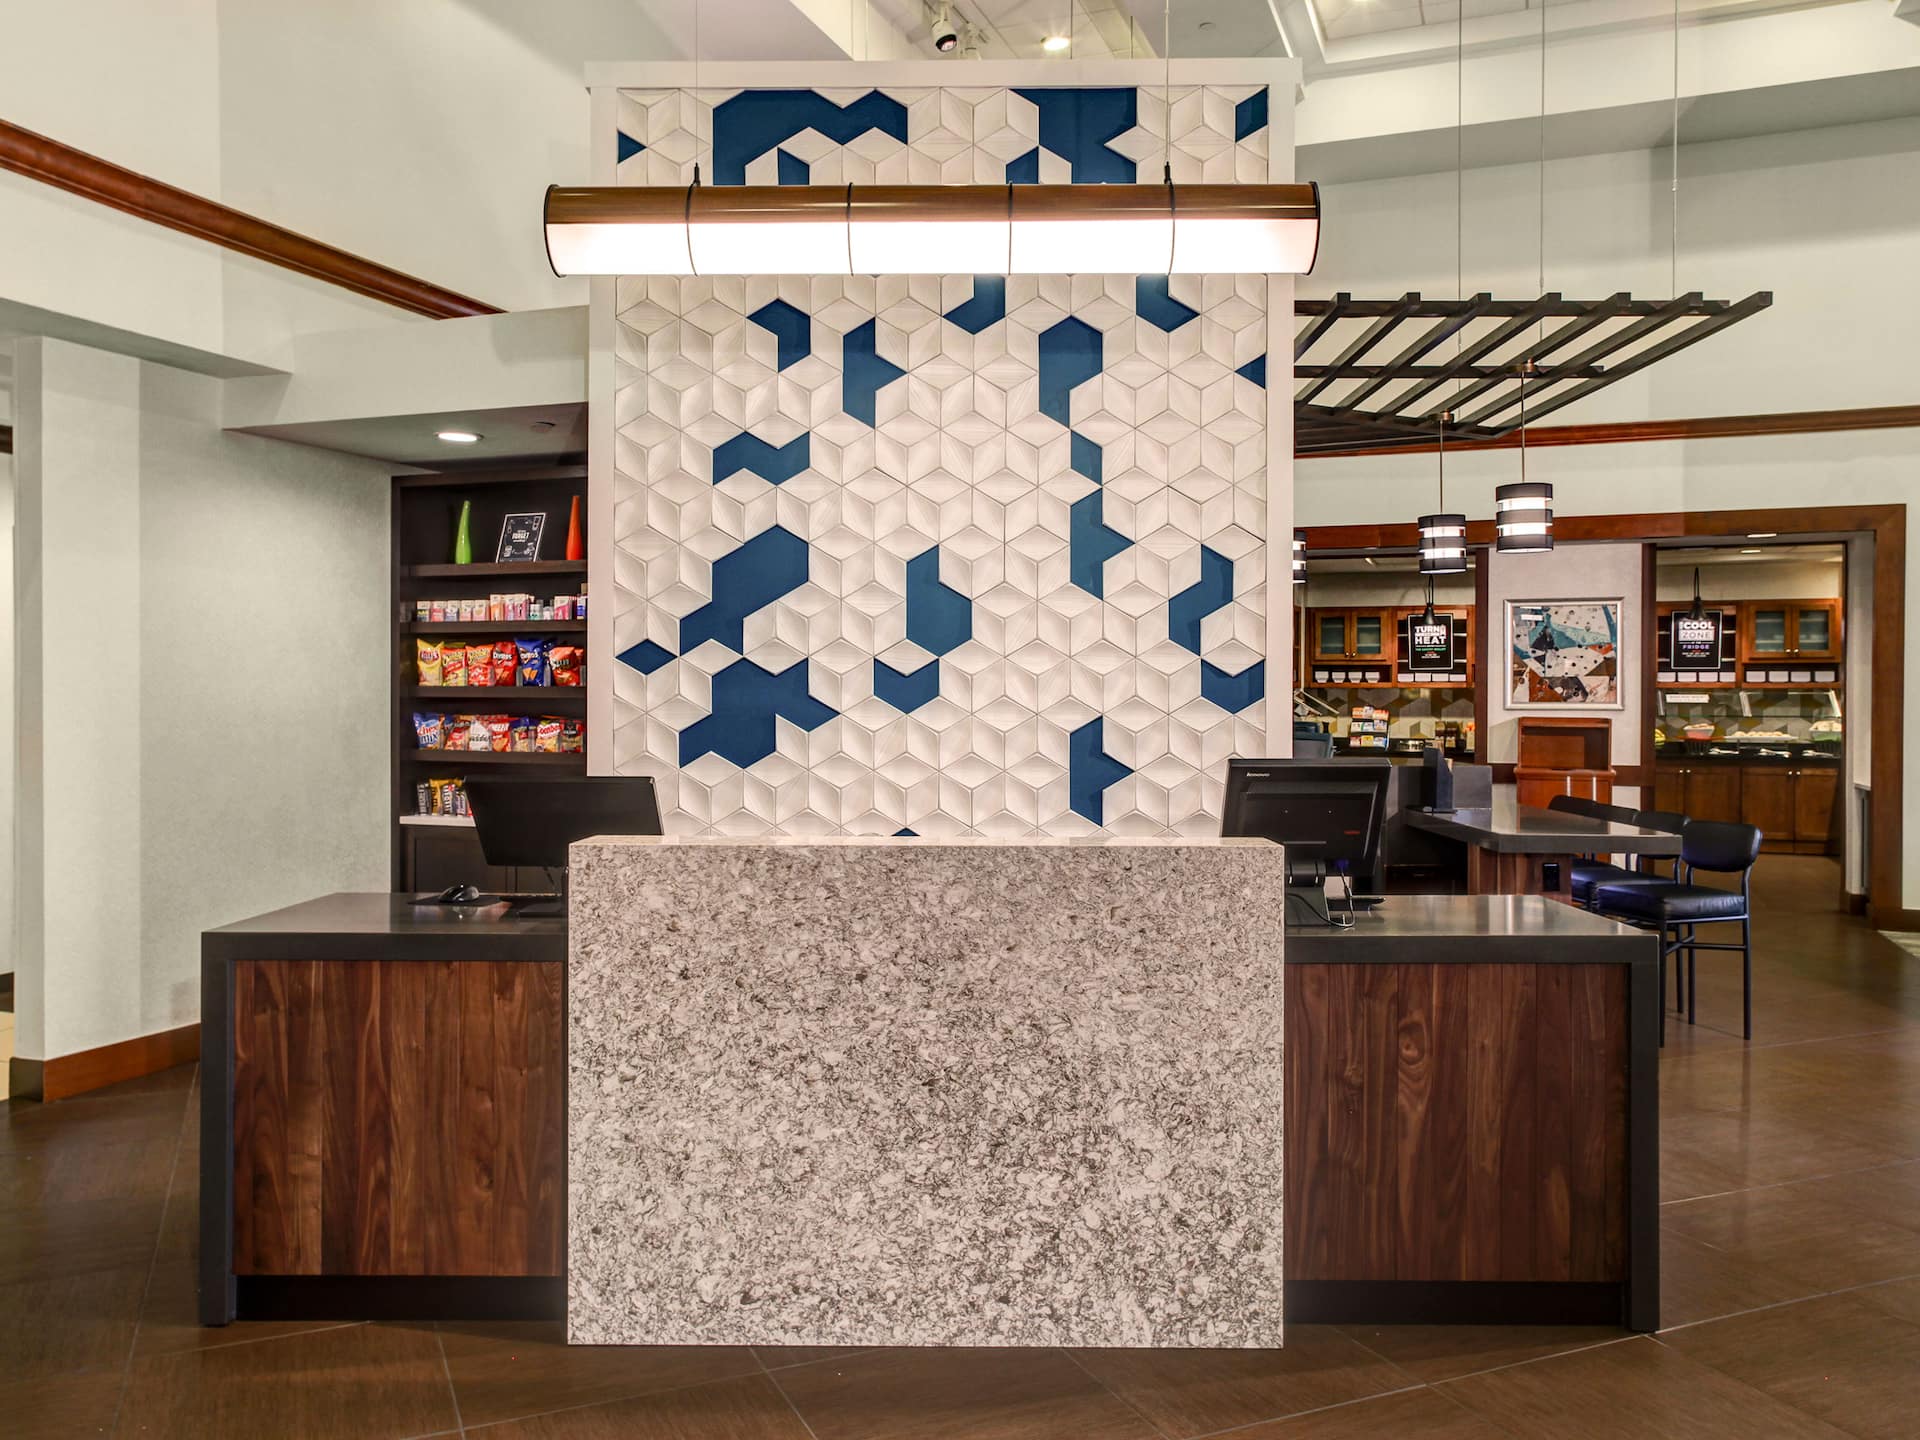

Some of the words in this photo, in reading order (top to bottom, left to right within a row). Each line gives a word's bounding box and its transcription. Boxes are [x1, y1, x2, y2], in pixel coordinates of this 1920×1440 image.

[1683, 621, 1715, 630] COOL
[1682, 631, 1712, 639] ZONE
[1414, 635, 1447, 645] HEAT
